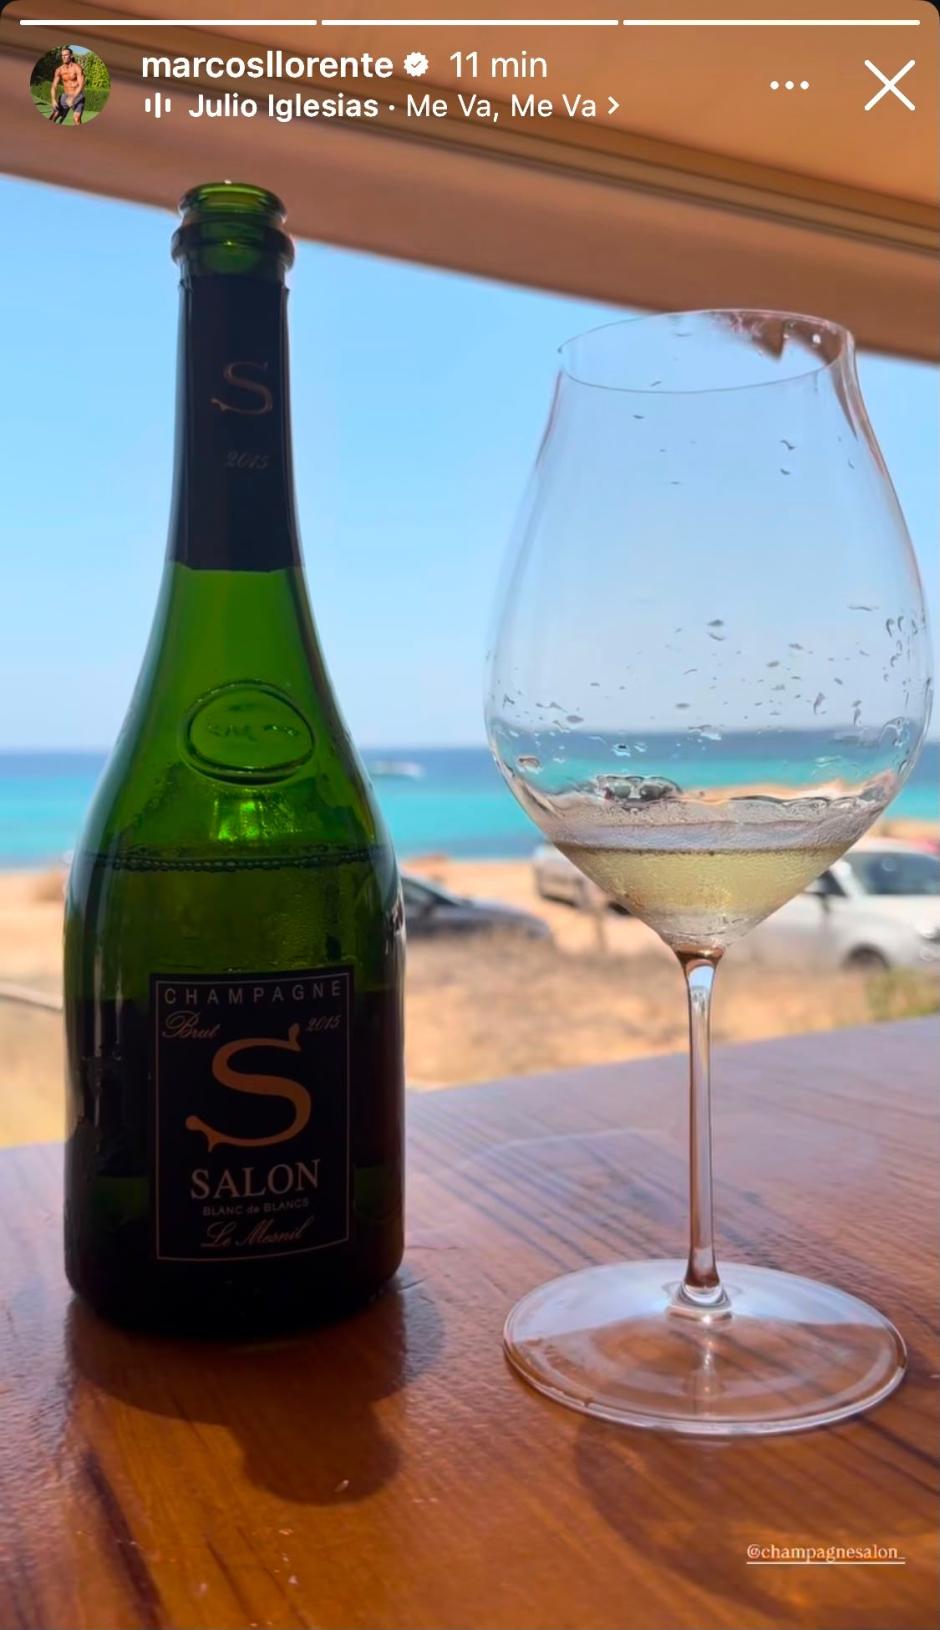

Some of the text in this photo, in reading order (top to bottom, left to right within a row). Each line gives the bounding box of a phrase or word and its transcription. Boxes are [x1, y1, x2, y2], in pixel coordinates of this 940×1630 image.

[209, 360, 273, 415] S
[163, 980, 342, 1004] CHAMPAGNE
[162, 1010, 342, 1040] Brut 2015
[184, 1022, 312, 1153] S
[190, 1158, 321, 1200] SALON
[203, 1197, 310, 1217] BLANC de BLANCS
[200, 1215, 315, 1248] Le Mesnil
